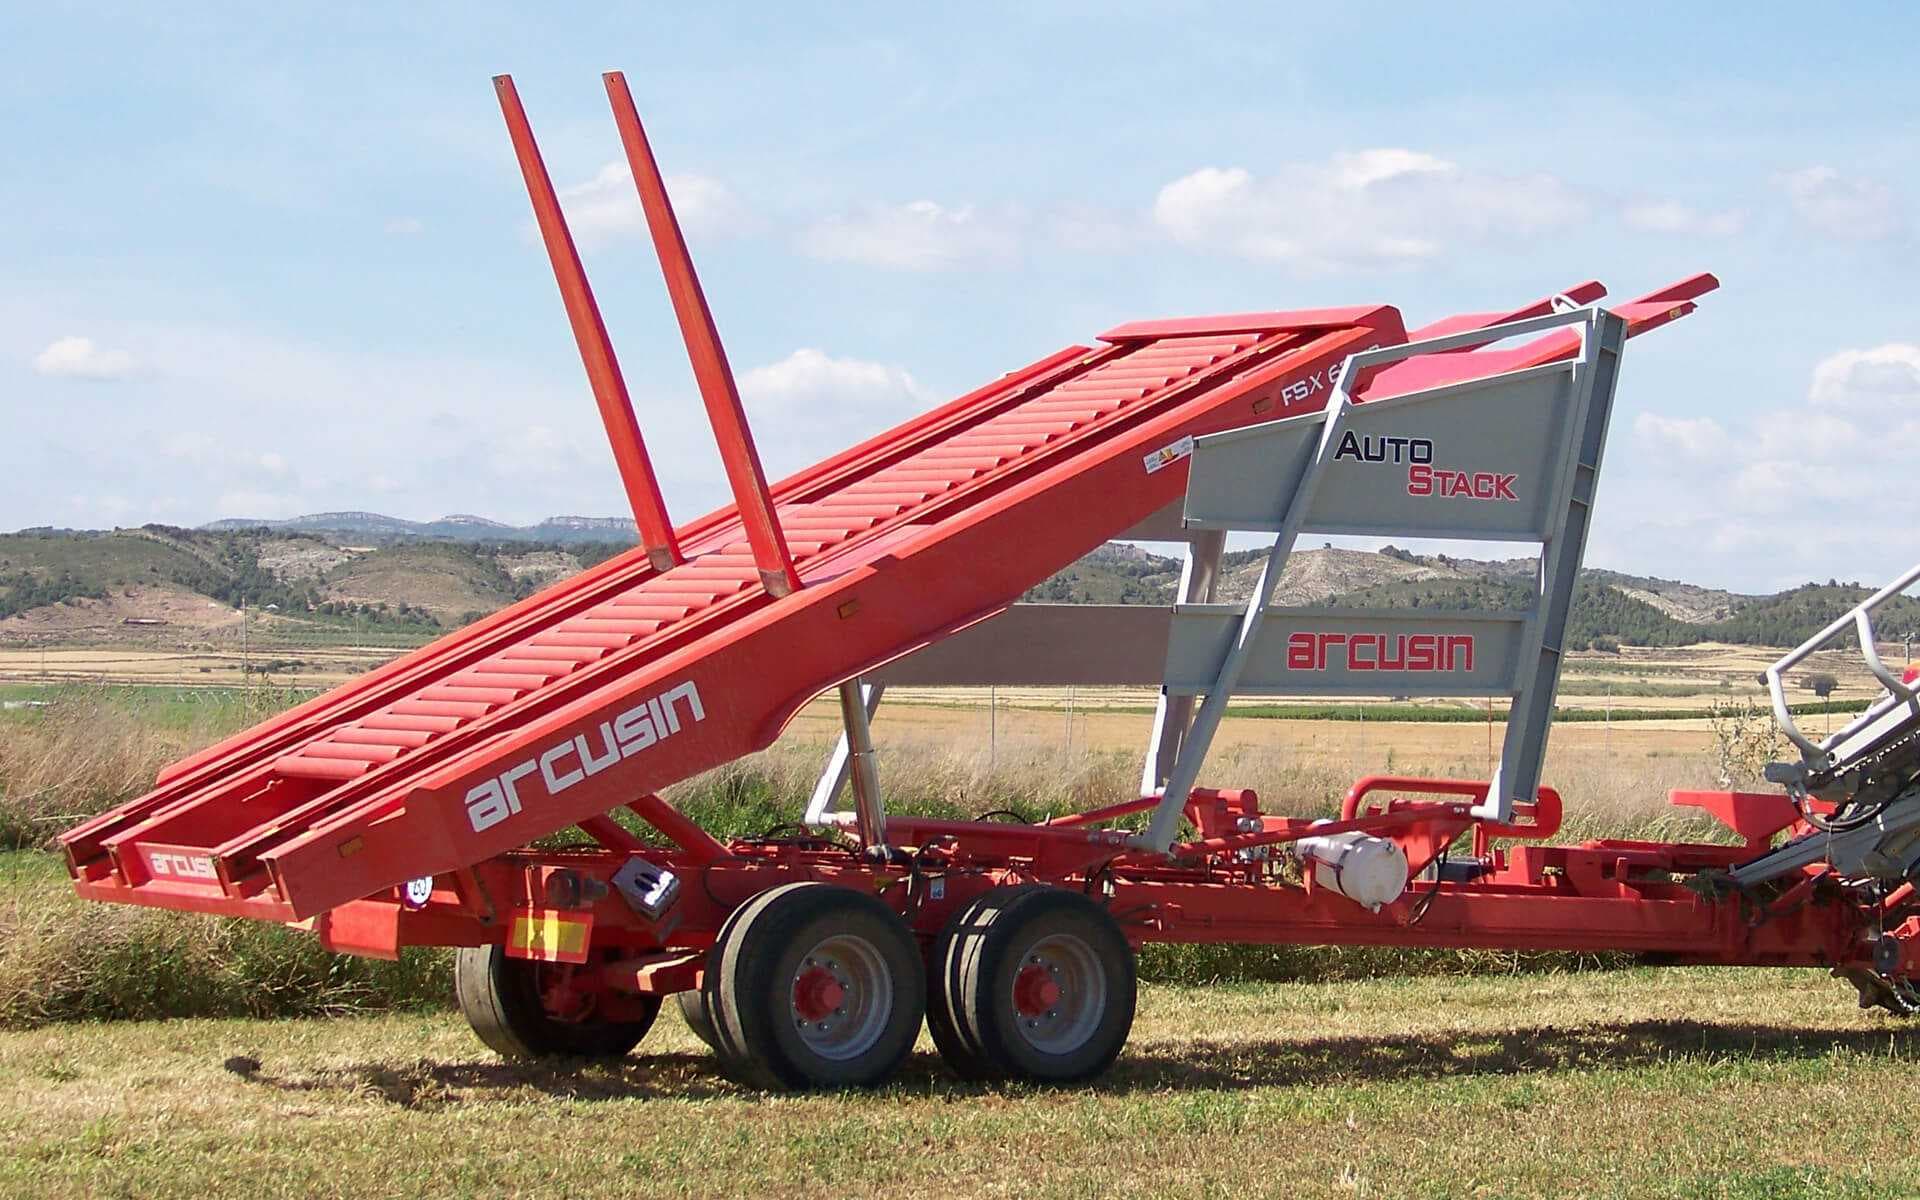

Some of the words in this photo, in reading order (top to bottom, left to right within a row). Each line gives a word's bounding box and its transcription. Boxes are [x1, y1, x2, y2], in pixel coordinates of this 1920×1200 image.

[1281, 371, 1323, 406] FSX
[1288, 633, 1474, 671] arcusin
[465, 680, 705, 832] arcusin
